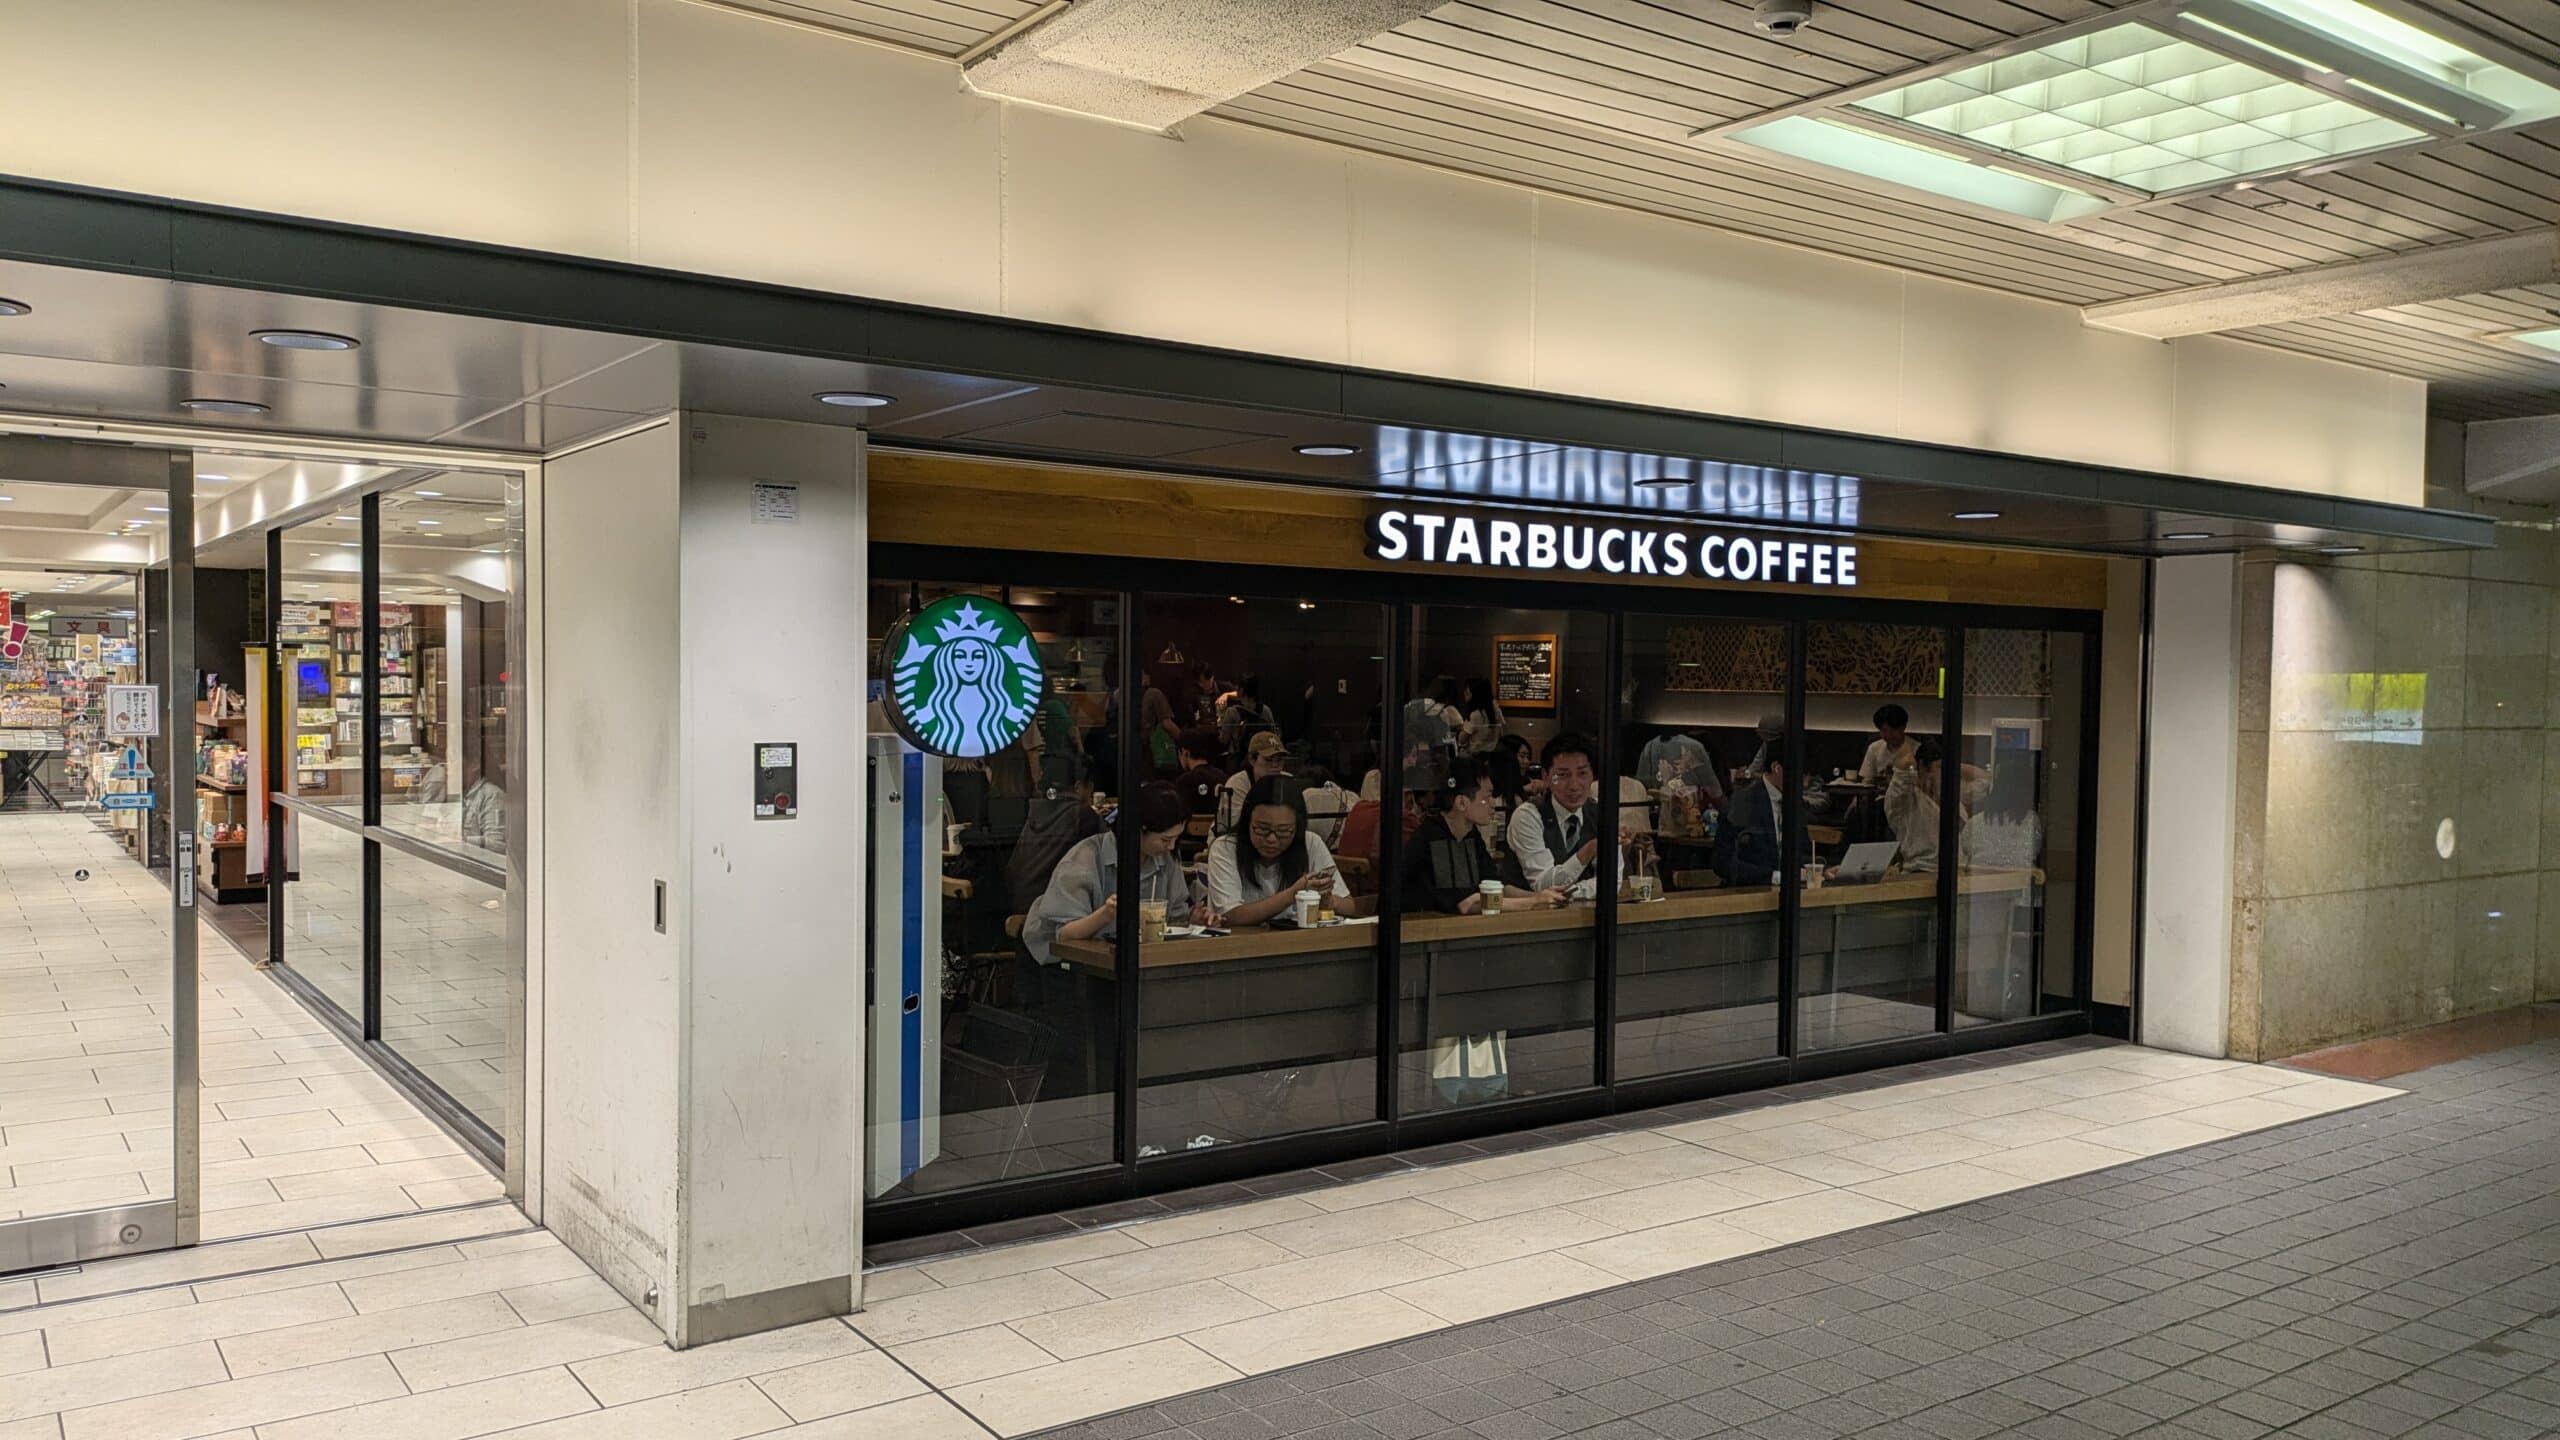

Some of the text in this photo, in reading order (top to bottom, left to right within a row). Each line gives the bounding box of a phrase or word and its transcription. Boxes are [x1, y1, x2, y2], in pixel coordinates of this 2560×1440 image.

[1377, 511, 1858, 586] STARBUCKS COFFEE
[66, 620, 112, 634] 文具
